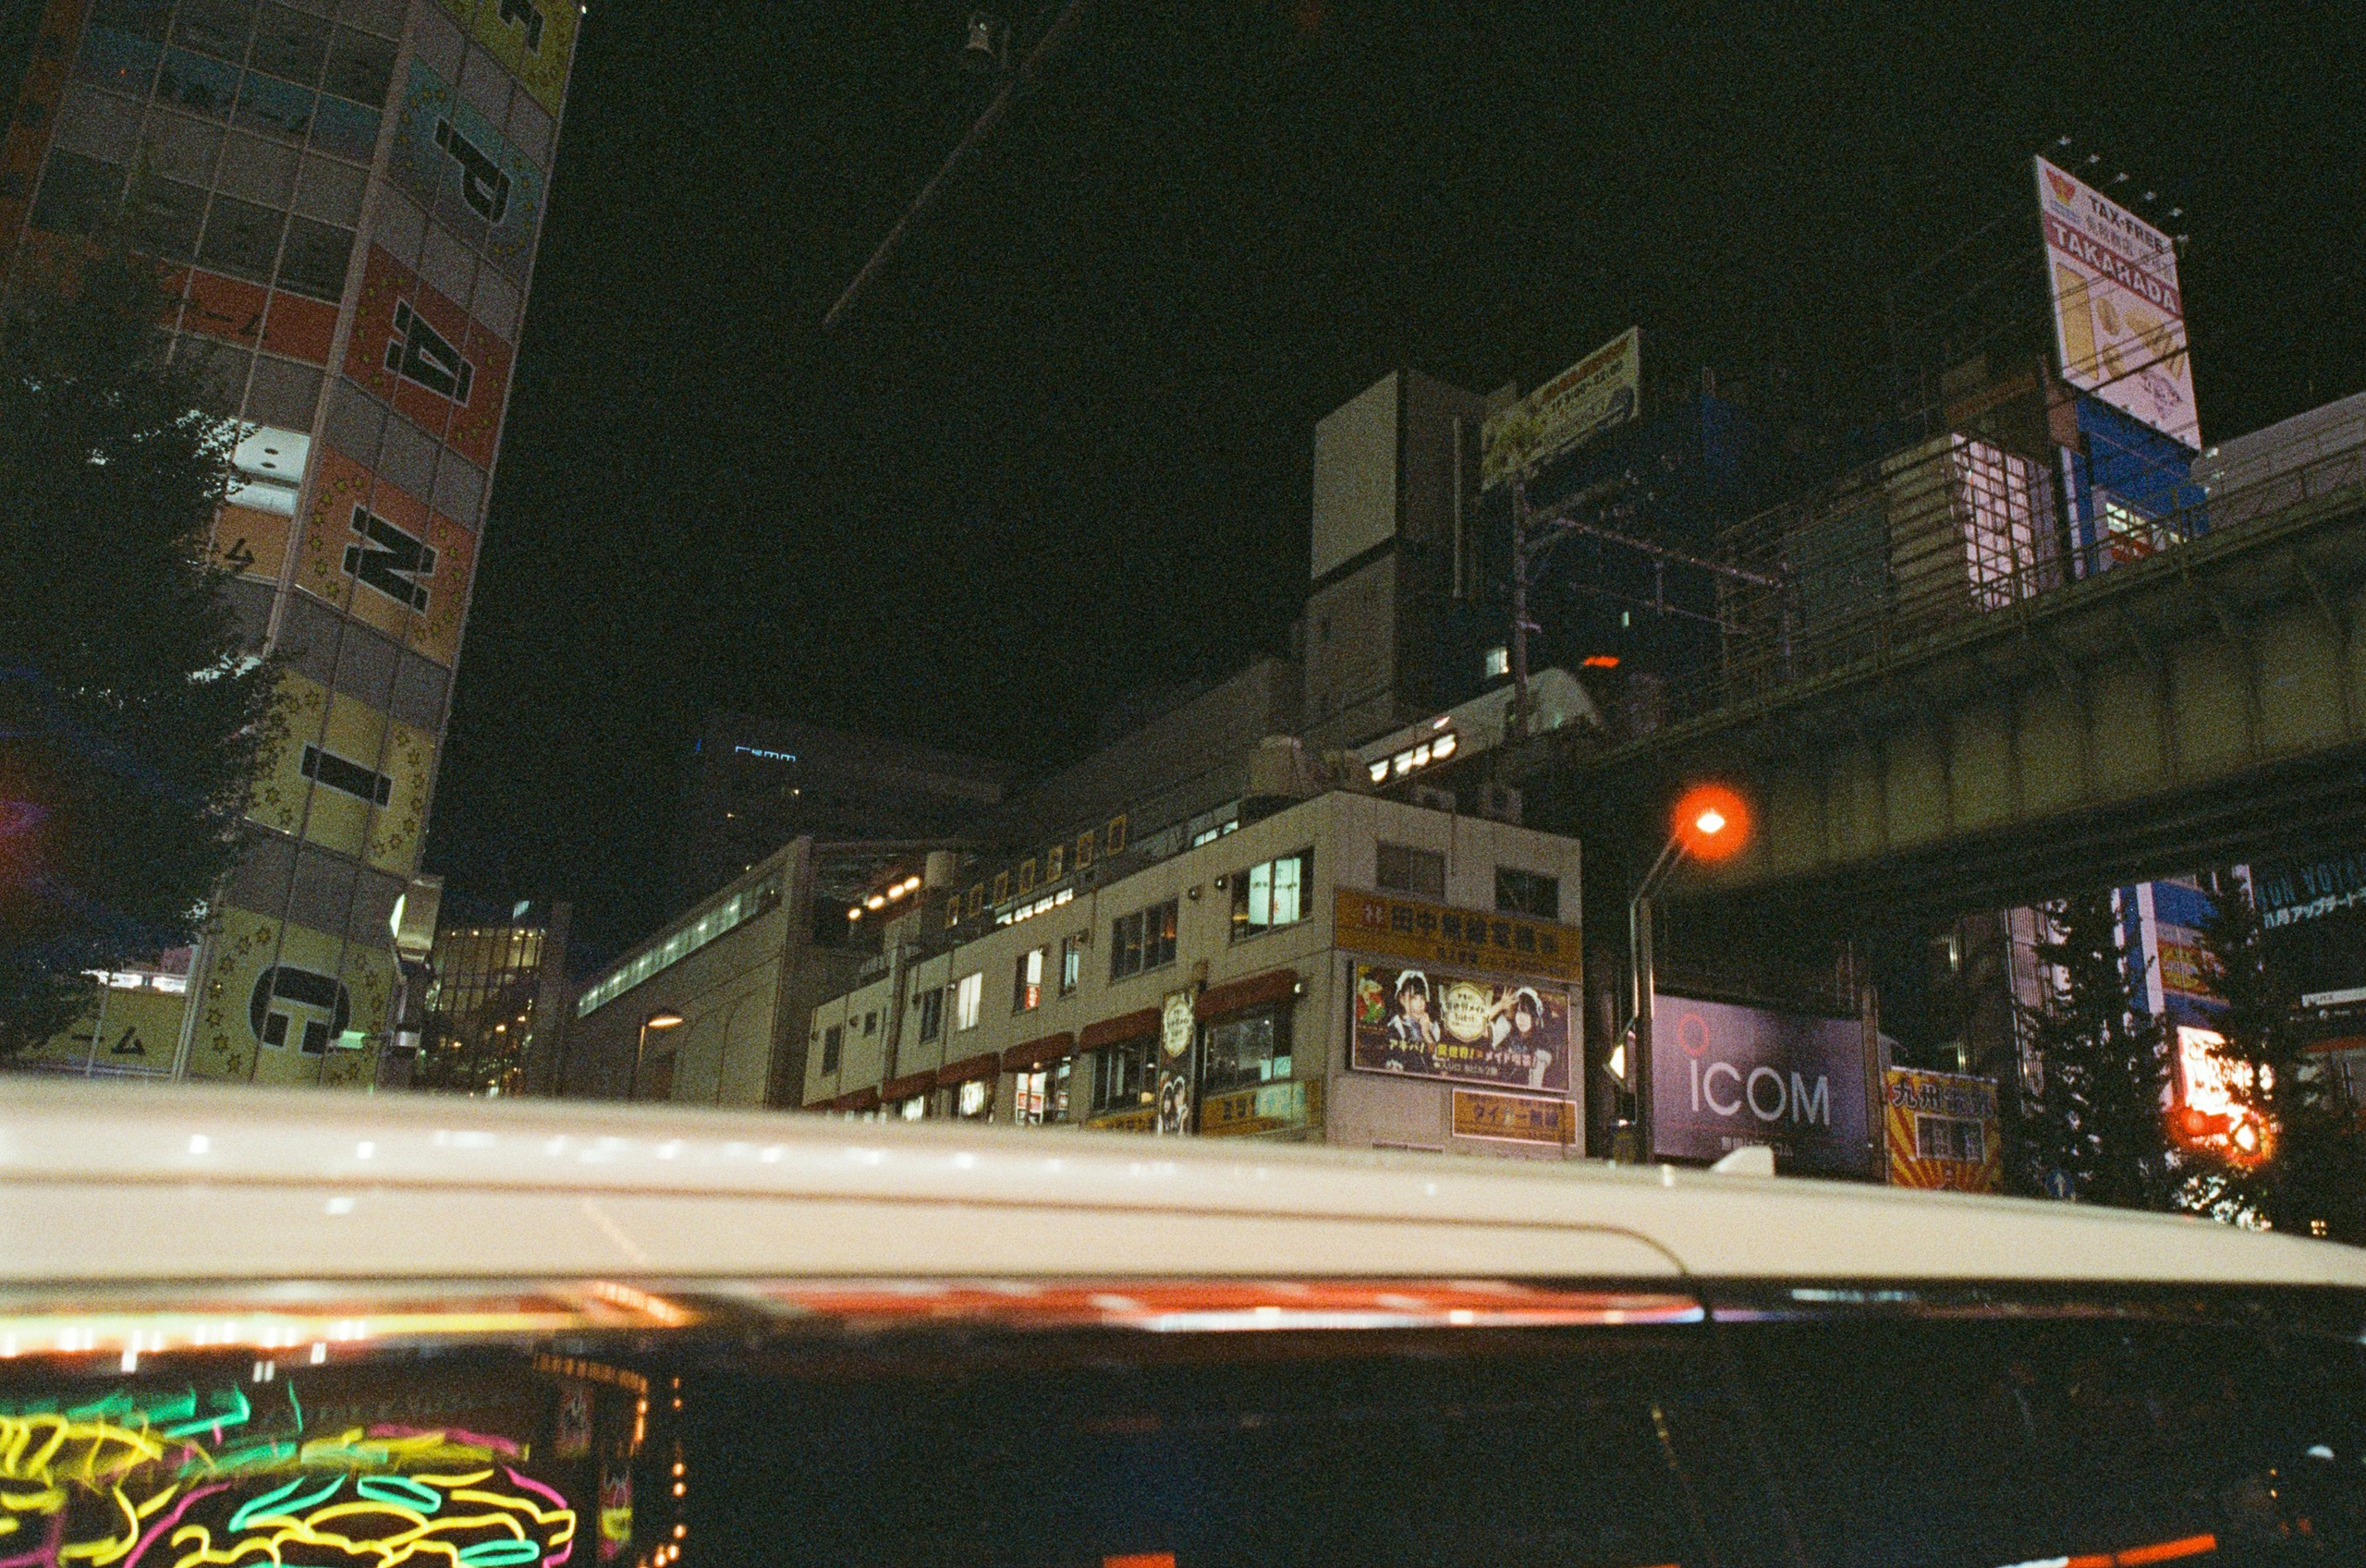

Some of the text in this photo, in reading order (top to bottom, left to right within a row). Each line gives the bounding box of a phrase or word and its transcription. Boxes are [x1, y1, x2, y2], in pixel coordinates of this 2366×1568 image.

[2050, 220, 2177, 314] TAKARADA
[735, 745, 797, 763] remm
[1689, 1058, 1831, 1126] ICOM
